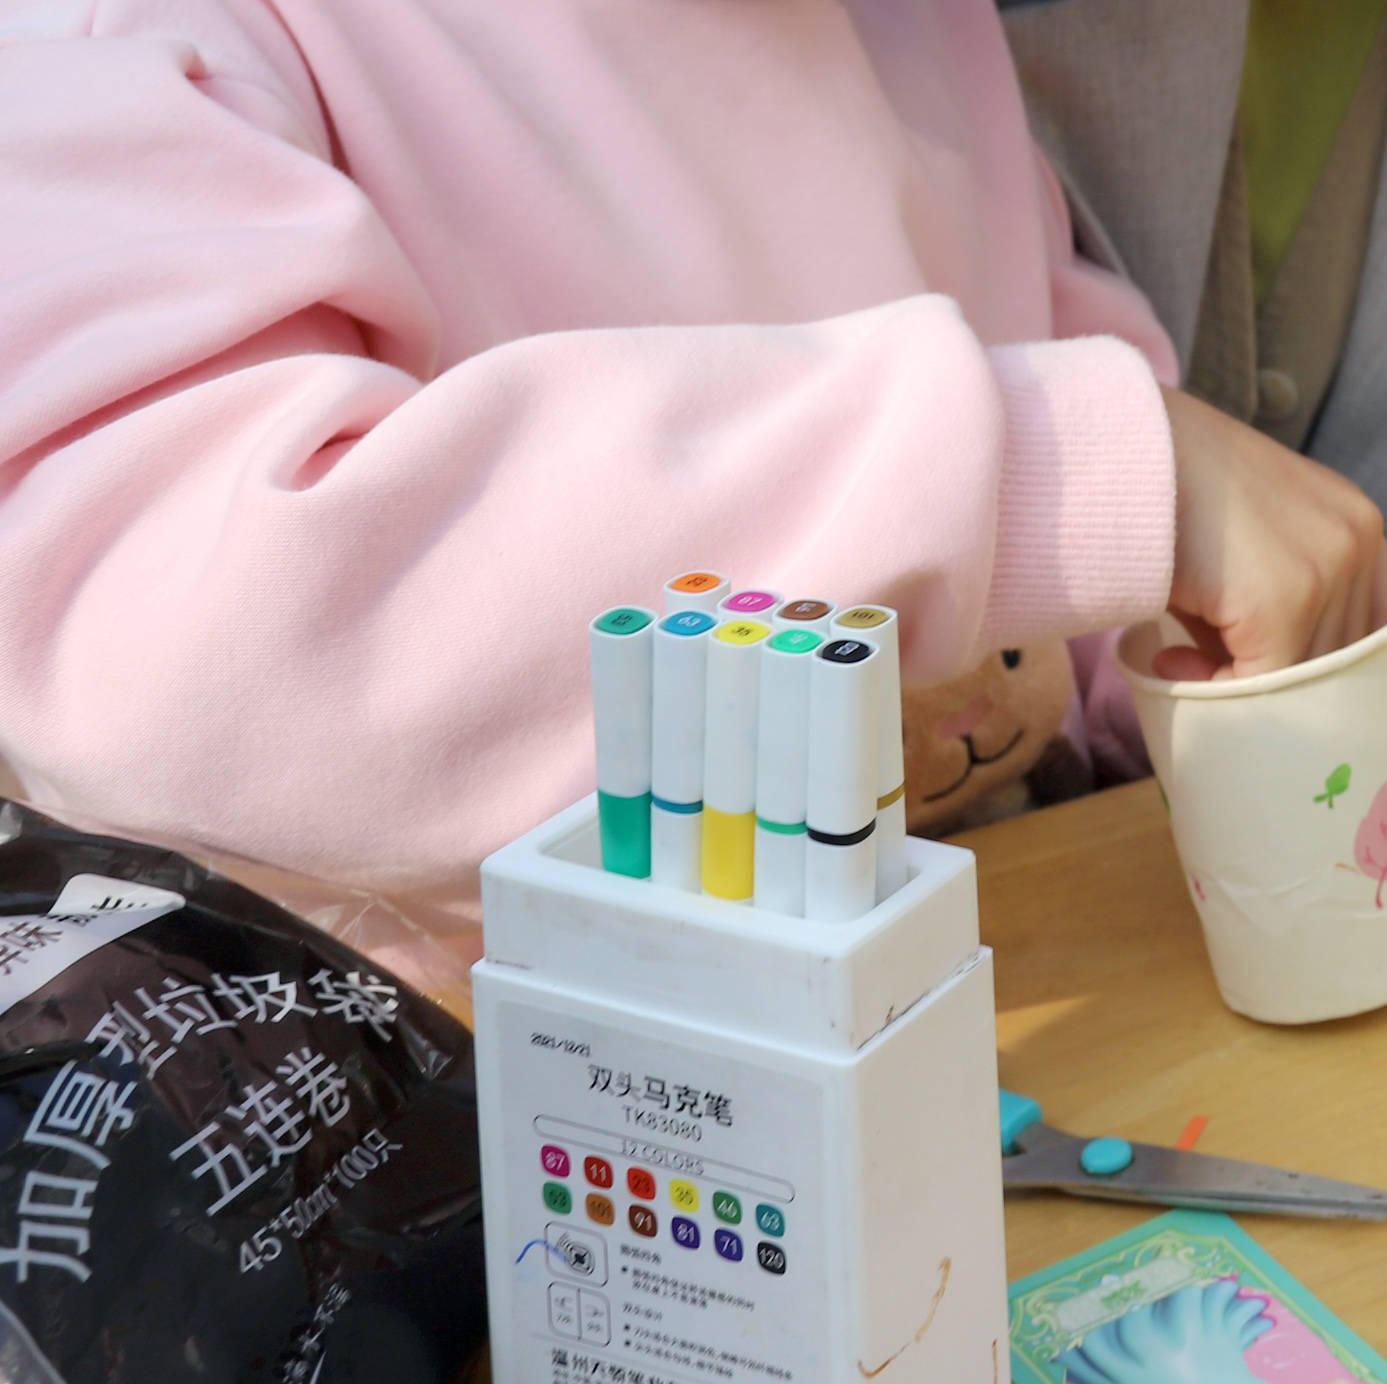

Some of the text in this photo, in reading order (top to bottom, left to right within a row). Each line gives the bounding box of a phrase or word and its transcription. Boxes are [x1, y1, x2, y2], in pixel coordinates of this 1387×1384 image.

[587, 1063, 733, 1128] 双头马克笔
[169, 1045, 352, 1217] 五连卷
[589, 1163, 607, 1183] 11
[676, 1223, 696, 1244] 81
[719, 1235, 739, 1256] 71
